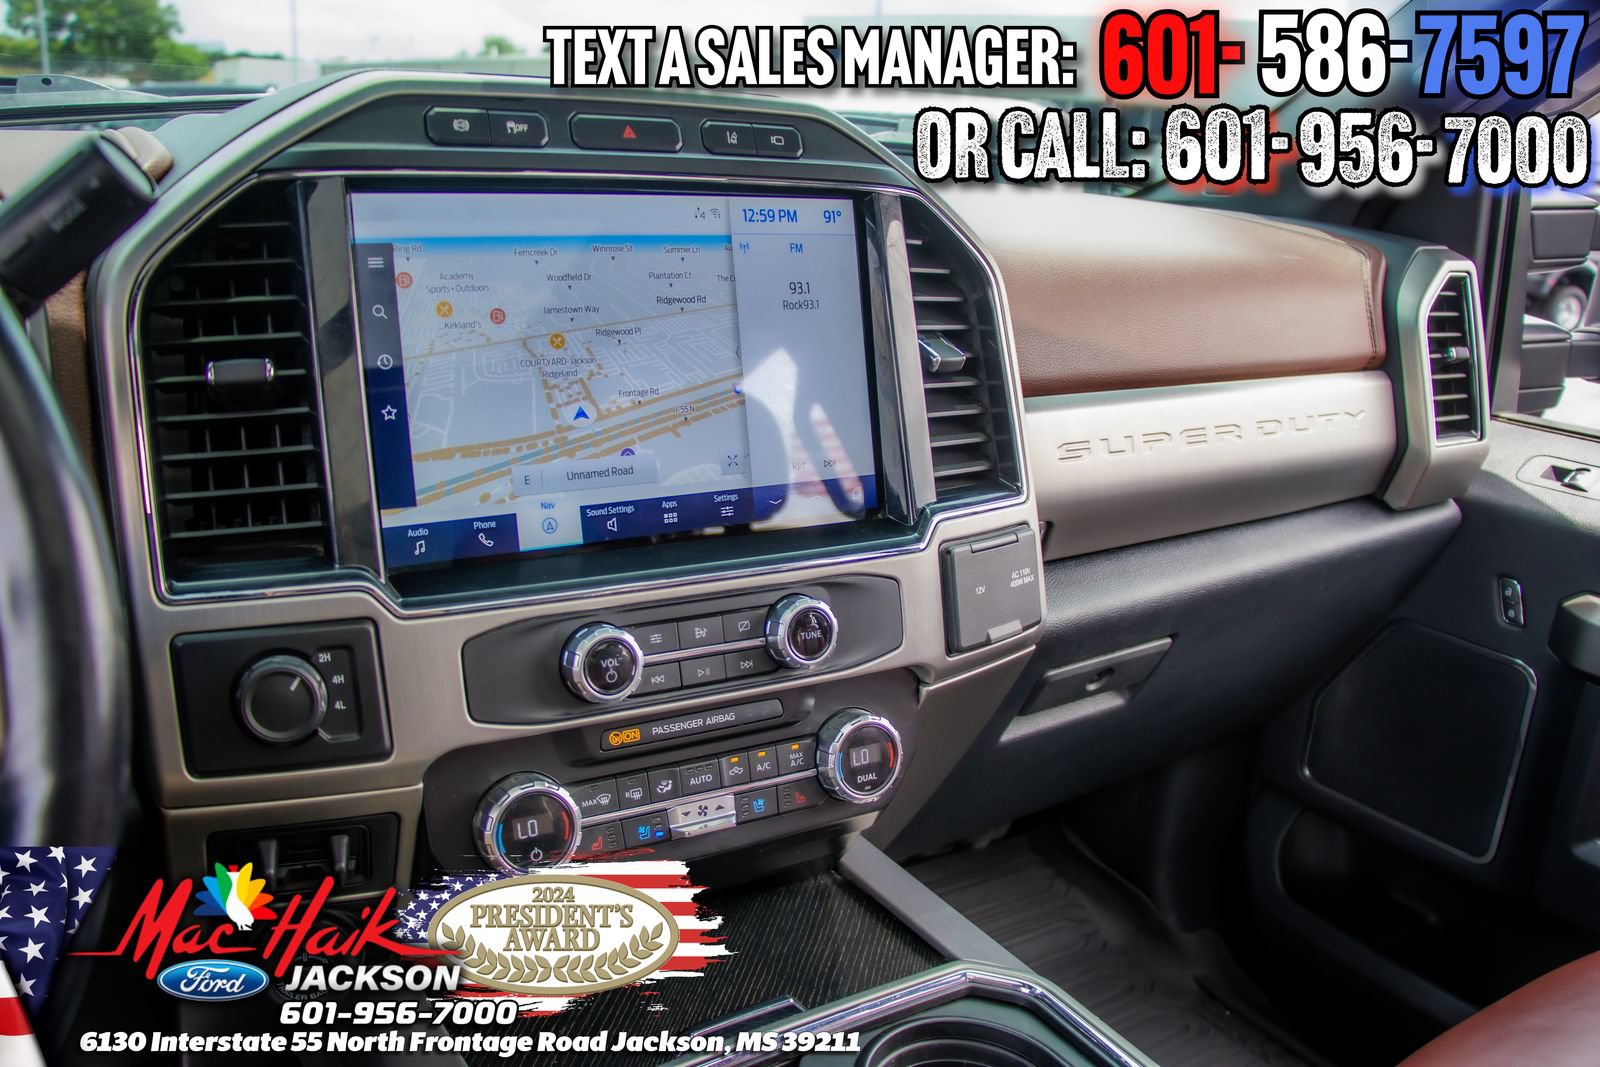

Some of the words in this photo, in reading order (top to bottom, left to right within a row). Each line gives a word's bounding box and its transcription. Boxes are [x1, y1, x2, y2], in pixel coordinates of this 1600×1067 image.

[515, 123, 528, 132] OFF
[742, 208, 776, 223] 12:59
[778, 209, 798, 223] PM
[663, 246, 692, 254] Summer
[692, 245, 701, 253] Ln
[790, 243, 804, 253] FM
[439, 272, 474, 281] Academy
[547, 273, 583, 282] Woodfield
[584, 273, 592, 281] Dr
[649, 272, 683, 280] Plantation
[789, 281, 811, 294] 93.1
[656, 295, 696, 305] Ridgewood
[697, 295, 707, 303] Rd
[783, 300, 820, 310] Rock93.1
[543, 306, 583, 315] Jamestown
[584, 305, 600, 314] Way
[444, 320, 482, 329] Kirkland's
[595, 328, 634, 336] Ridgewood
[542, 369, 578, 379] Ridgeland
[618, 389, 649, 398] Frontage
[649, 387, 660, 396] Rd
[1057, 423, 1243, 464] SUPER
[1256, 410, 1366, 440] DUTY
[567, 467, 610, 481] Unnamed
[611, 466, 634, 477] Road
[524, 475, 531, 485] E
[713, 493, 739, 503] Settings
[540, 501, 556, 510] Nav
[661, 500, 678, 509] Apps
[586, 507, 607, 517] Sound
[607, 505, 635, 516] Settings
[473, 520, 497, 530] Phone
[407, 527, 429, 538] Audio
[975, 585, 986, 595] 12V
[800, 629, 822, 640] TUNE
[318, 652, 331, 663] 2H
[601, 658, 620, 668] VOL
[332, 674, 345, 684] 4H
[334, 700, 346, 710] 4L
[652, 718, 704, 736] PASSENGER
[705, 712, 736, 727] AIRBAG
[624, 731, 639, 741] ON
[789, 751, 804, 760] MAX
[756, 762, 772, 772] A/C
[790, 758, 805, 768] A/C
[689, 774, 713, 785] AUTO
[857, 772, 878, 784] DUAL
[582, 799, 598, 808] MAX
